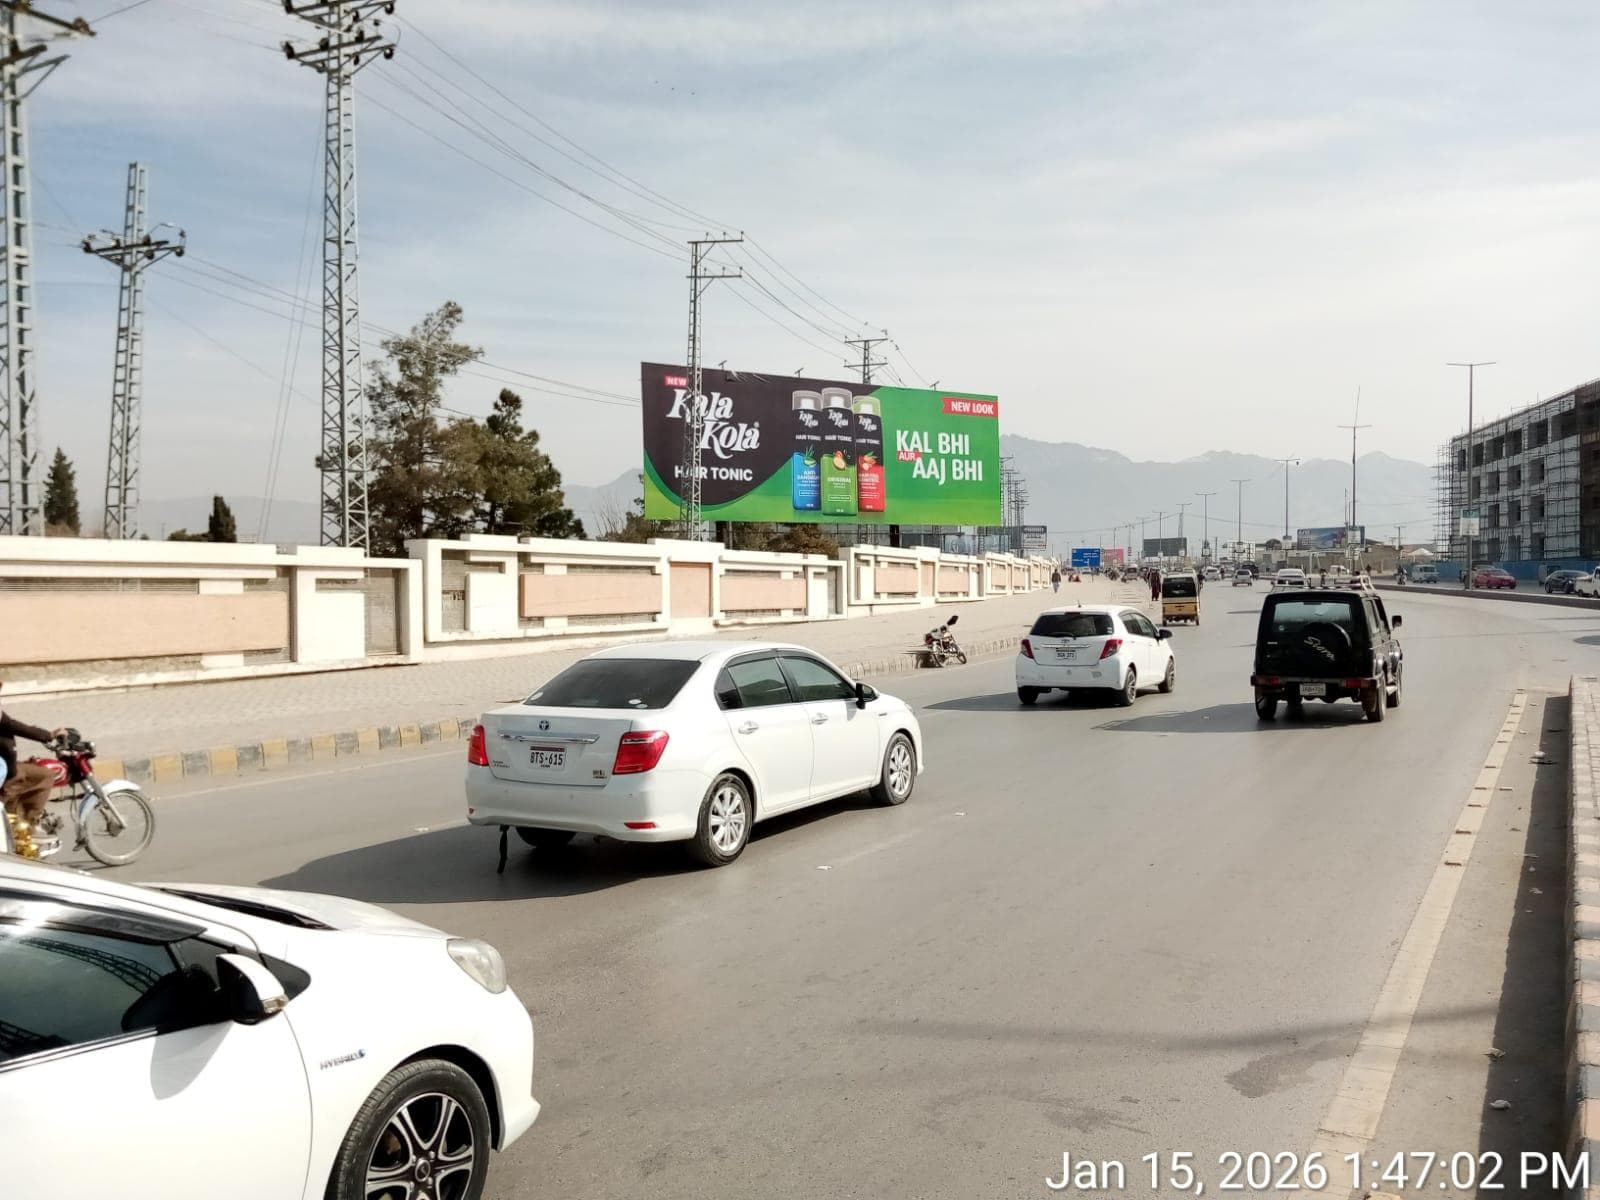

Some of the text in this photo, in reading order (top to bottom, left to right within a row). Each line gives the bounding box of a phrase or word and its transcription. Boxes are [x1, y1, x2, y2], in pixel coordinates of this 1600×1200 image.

[666, 376, 687, 386] NEW
[665, 388, 733, 424] Kala
[951, 401, 994, 415] NEW LOOK
[696, 420, 760, 459] Kola
[896, 430, 970, 455] KAL BHI
[898, 451, 915, 461] AUR
[710, 466, 753, 481] TONIC
[912, 457, 983, 485] AAJ BHI
